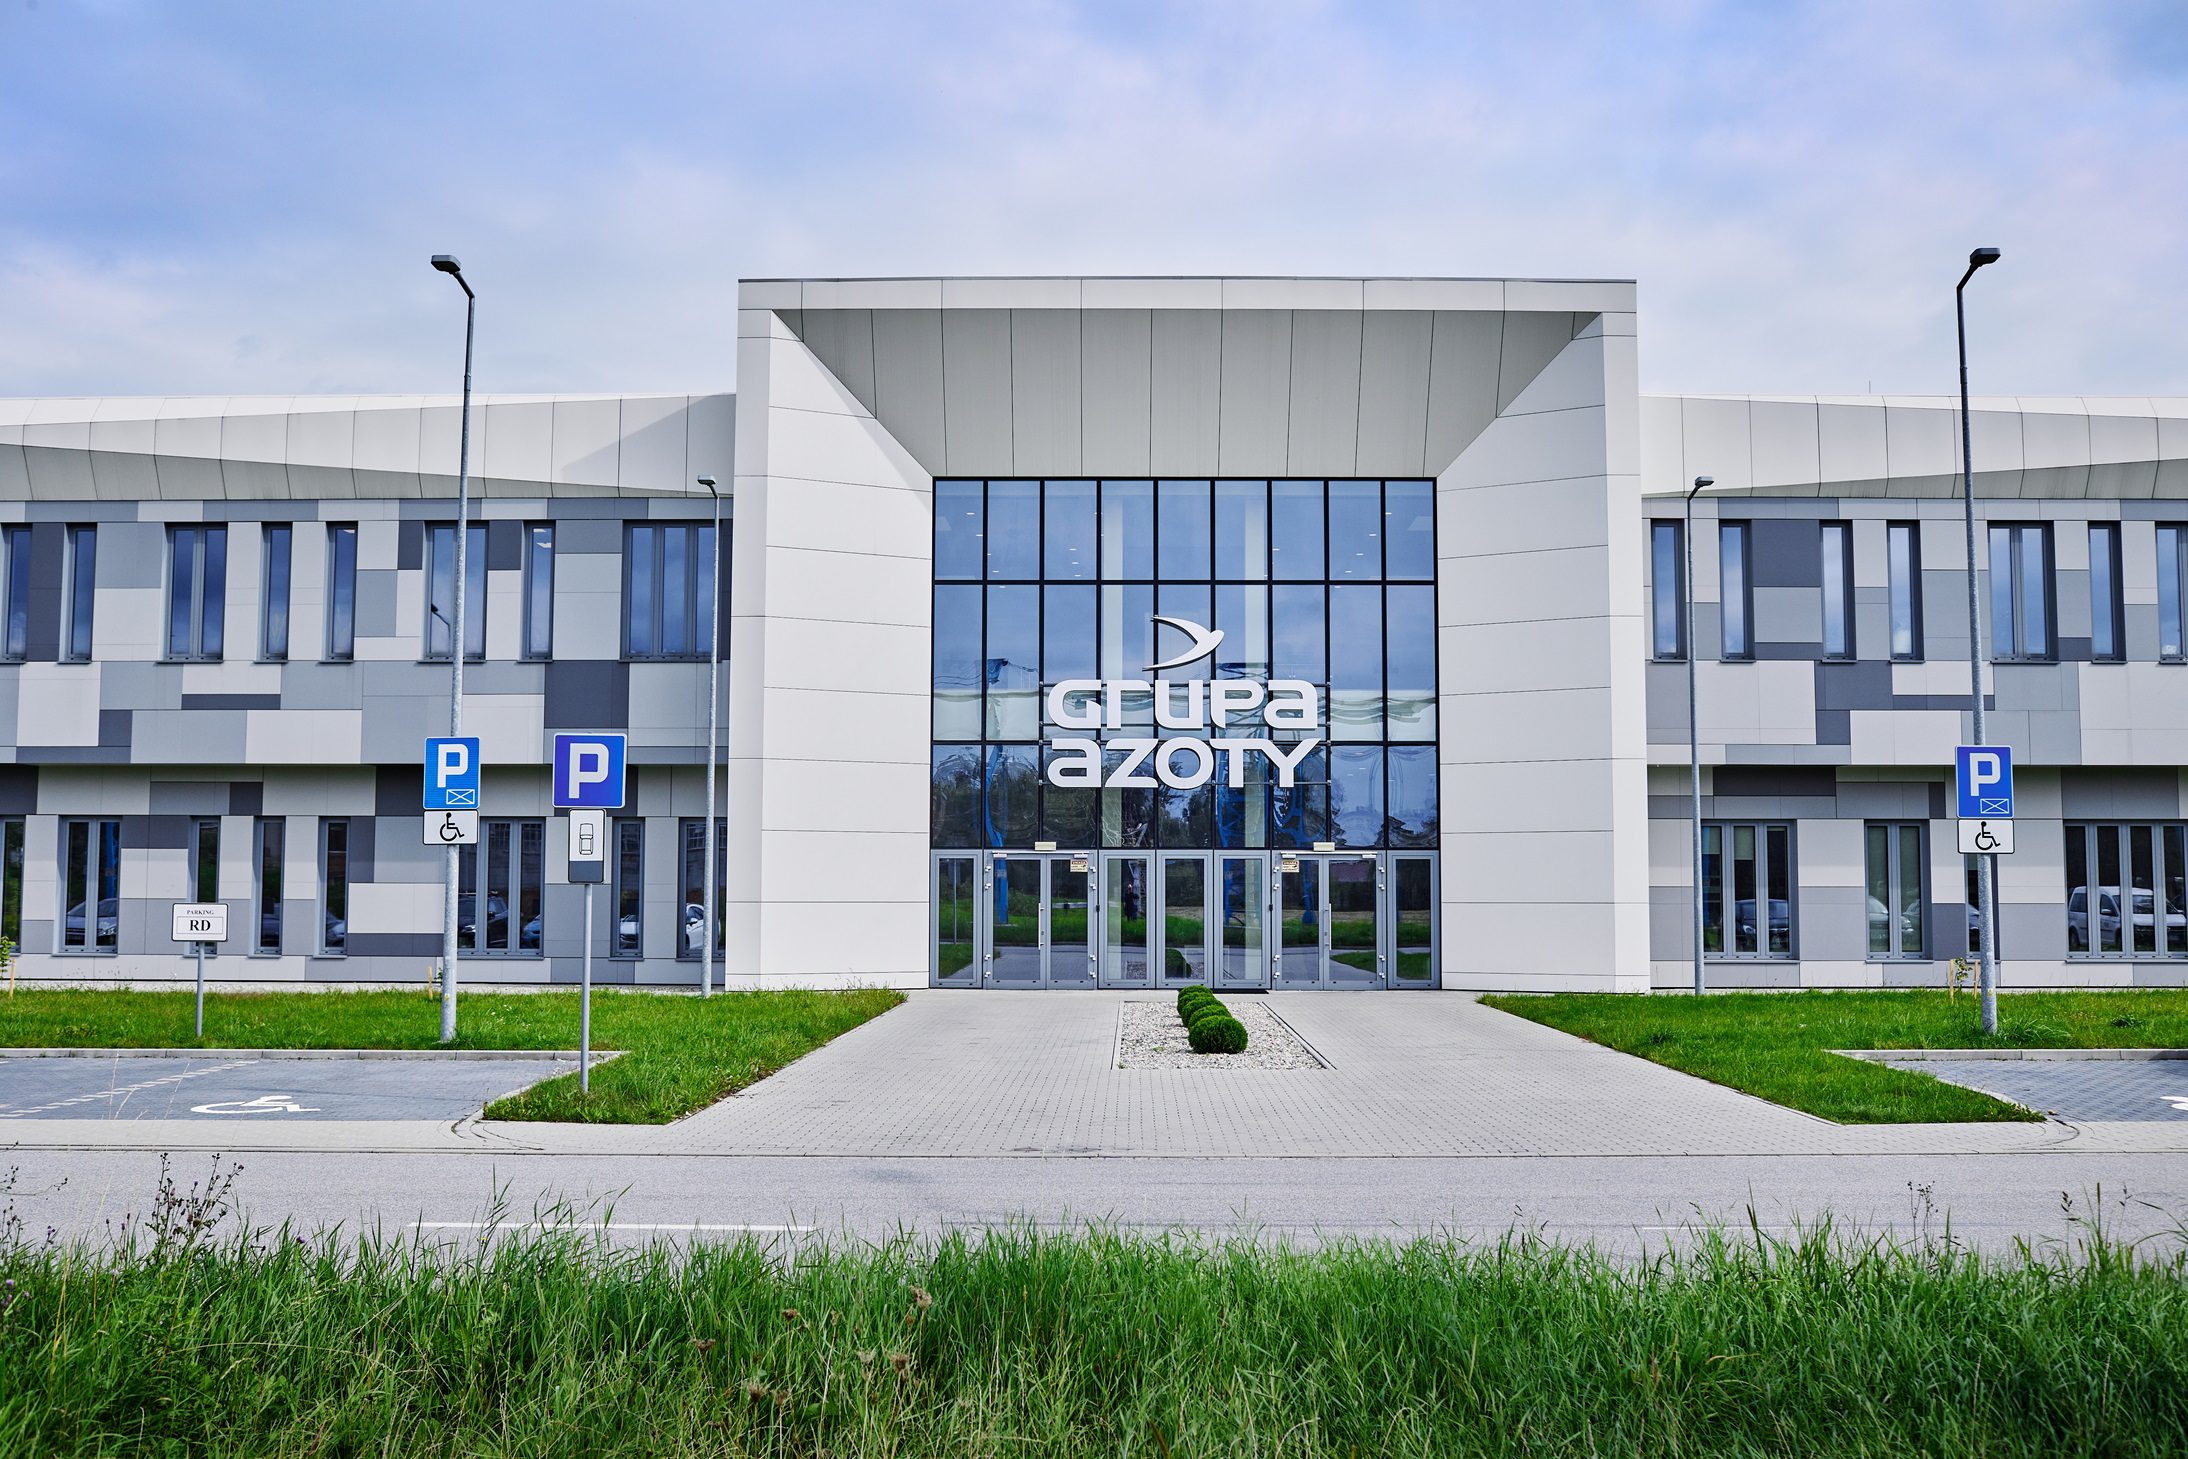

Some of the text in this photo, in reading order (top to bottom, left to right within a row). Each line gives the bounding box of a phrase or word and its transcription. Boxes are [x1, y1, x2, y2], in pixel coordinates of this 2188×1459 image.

[437, 743, 469, 788] P
[568, 742, 609, 799] P
[1969, 752, 2001, 797] P
[190, 919, 211, 931] RD
